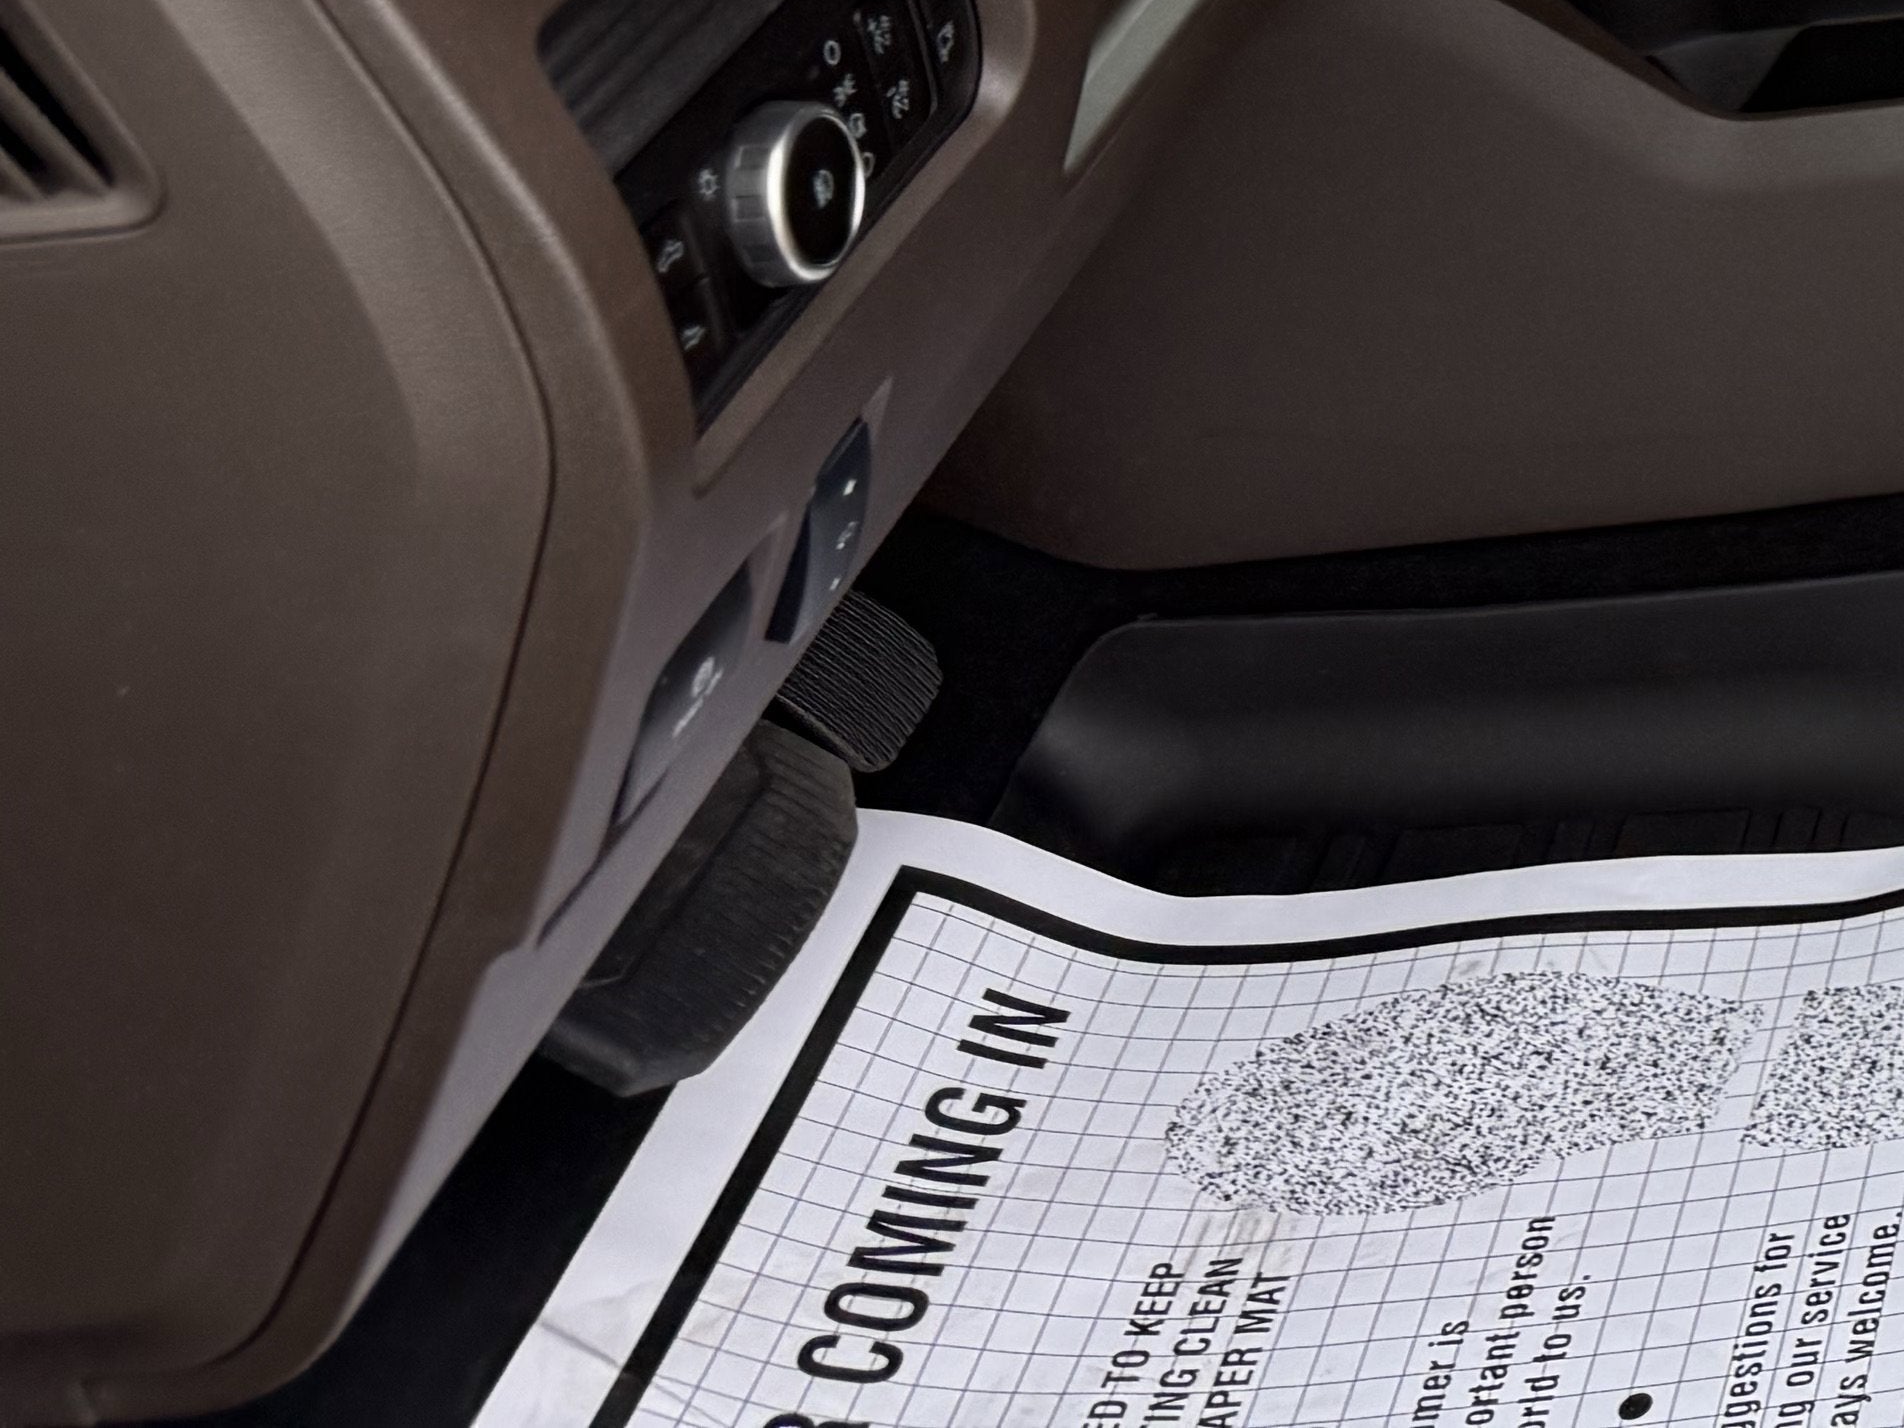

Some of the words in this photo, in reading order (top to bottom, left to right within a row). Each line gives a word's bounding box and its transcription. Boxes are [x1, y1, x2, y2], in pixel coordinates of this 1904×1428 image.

[797, 1086, 1027, 1384] COMING
[956, 987, 1072, 1070] IN
[1753, 1232, 1796, 1273] for
[1800, 1214, 1851, 1325] service
[1123, 1262, 1185, 1336] KEEP
[1233, 1271, 1292, 1335] MAT
[1551, 1274, 1592, 1321] us.
[1844, 1211, 1903, 1364] welcome.
[1139, 1368, 1201, 1428] ING
[1173, 1257, 1243, 1356] CLEAN
[1427, 1320, 1470, 1348] is
[1465, 1331, 1521, 1426] ortant
[1498, 1216, 1556, 1320] person
[1532, 1333, 1572, 1363] to
[1100, 1350, 1150, 1389] TO
[1409, 1359, 1456, 1428] mer
[1786, 1337, 1823, 1388] our
[1830, 1373, 1872, 1428] ays
